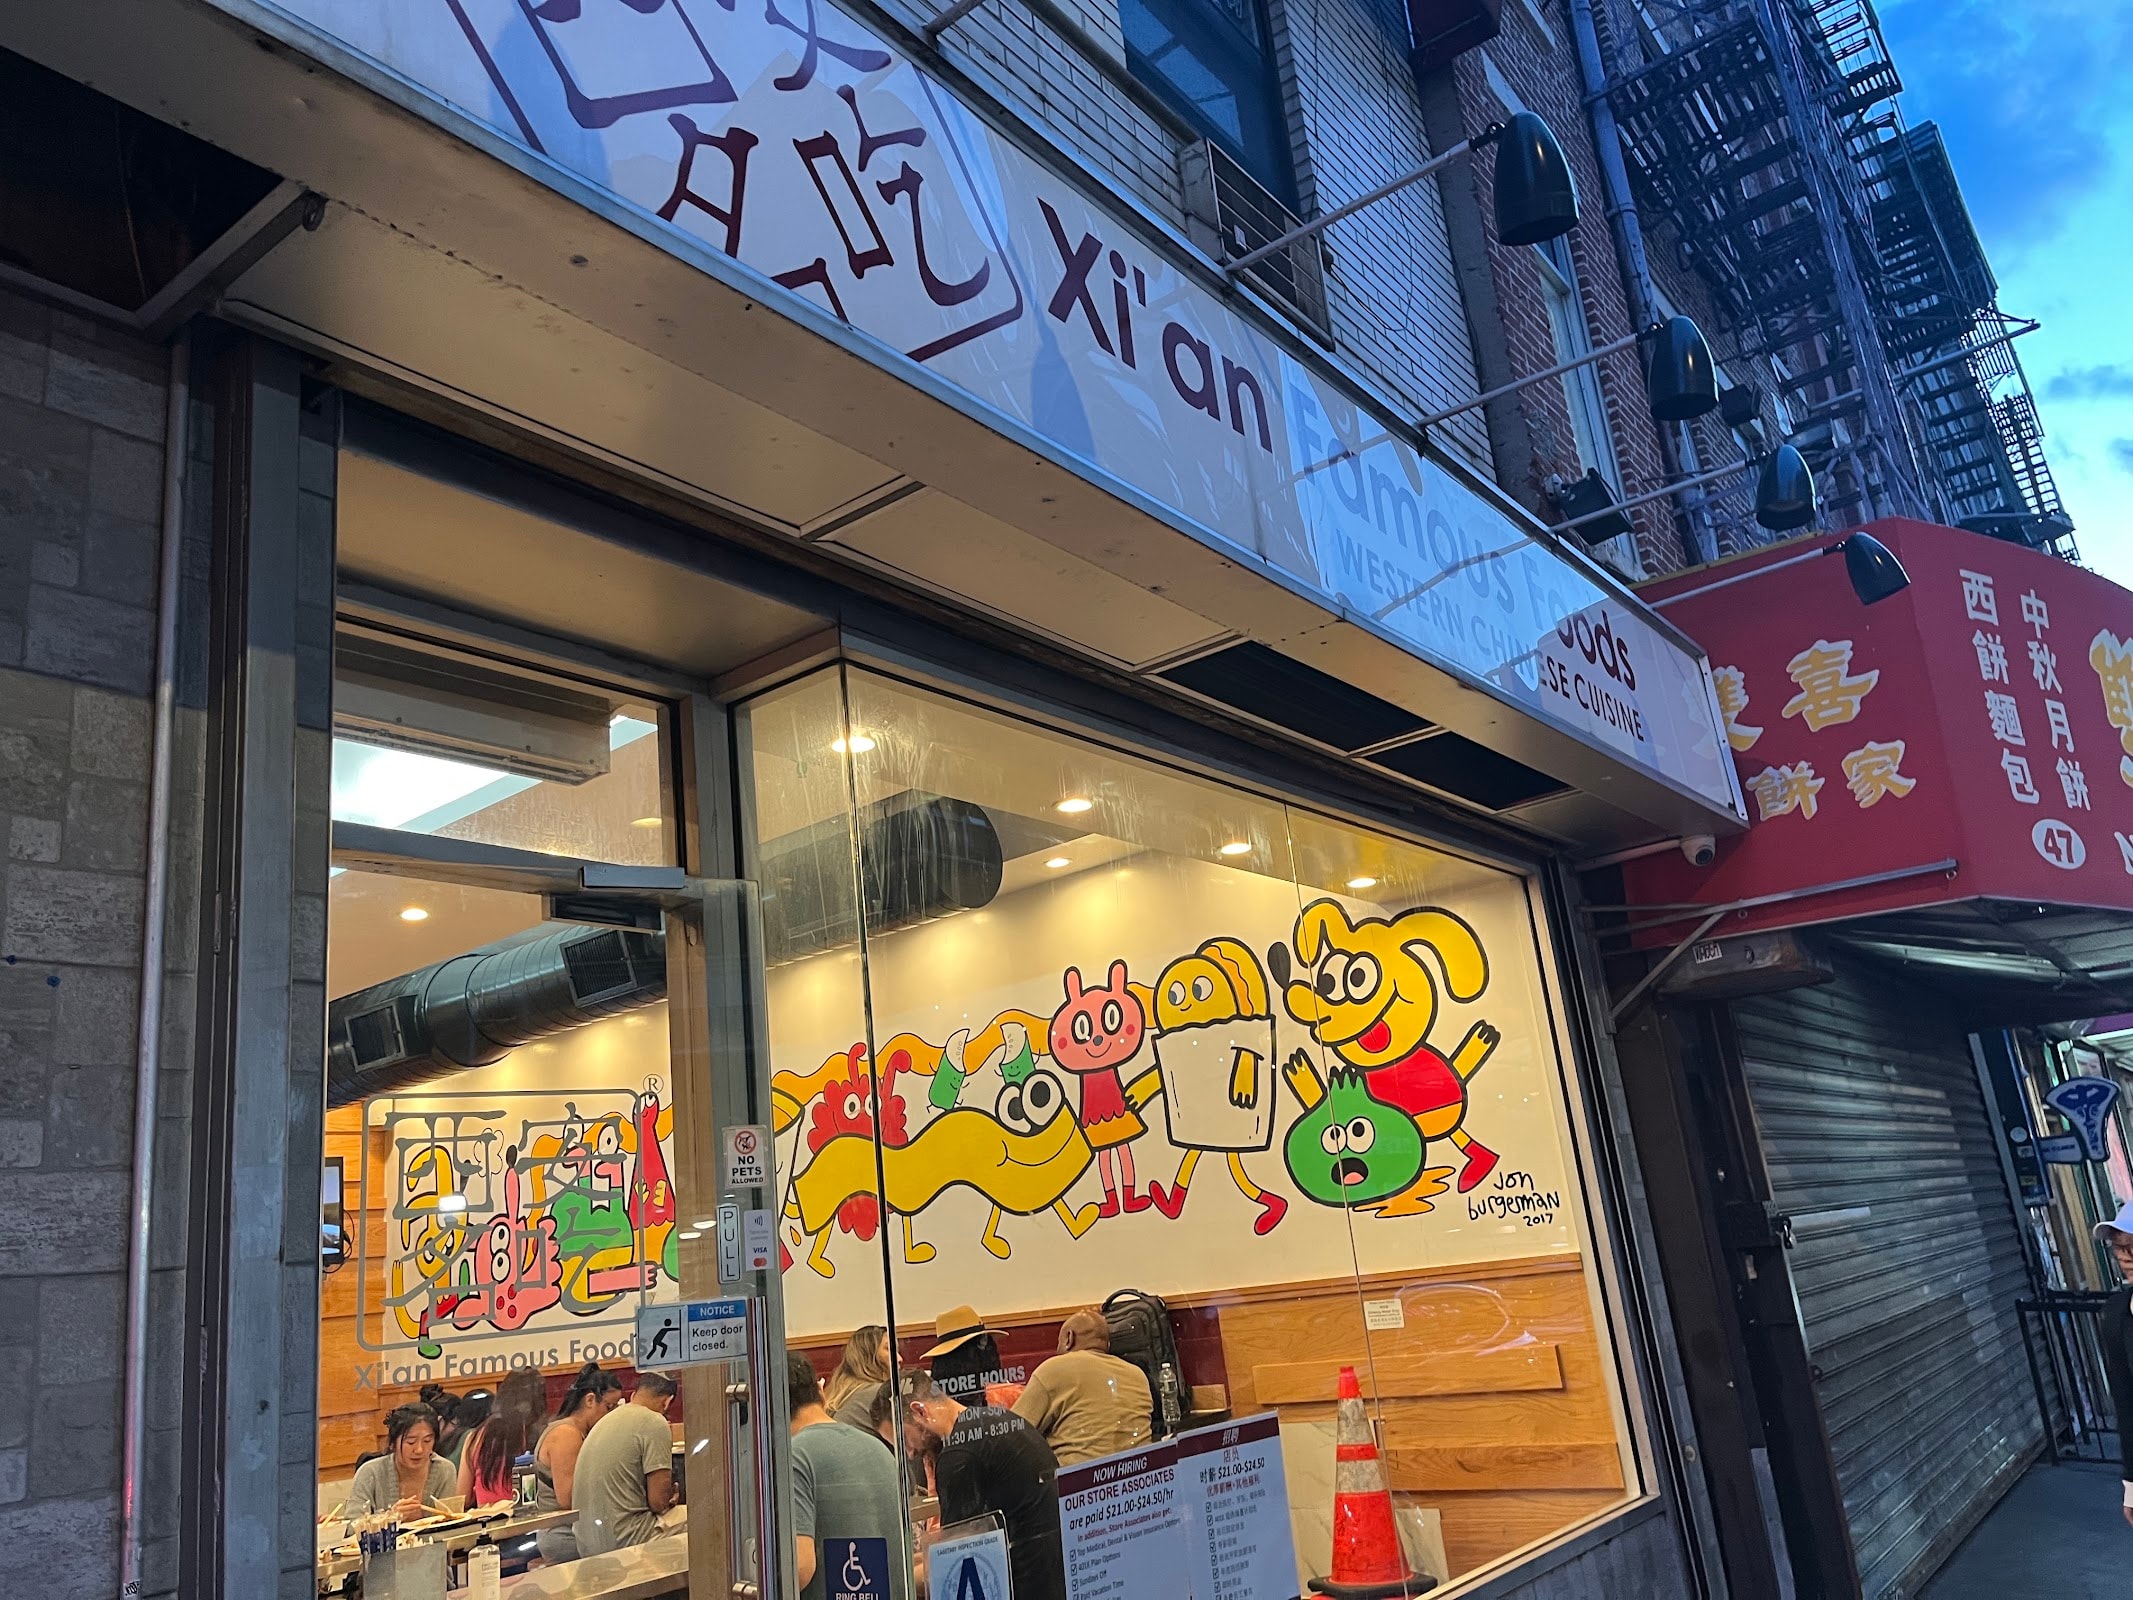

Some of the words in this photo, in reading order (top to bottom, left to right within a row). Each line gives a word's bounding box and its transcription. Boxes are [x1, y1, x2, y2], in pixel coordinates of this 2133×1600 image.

[1037, 198, 1273, 454] Xi'an
[1289, 381, 1515, 615] Famous
[1520, 551, 1637, 692] Foods
[1335, 529, 1466, 646] WESTERN
[1470, 615, 1571, 700] CHINESE
[1573, 673, 1646, 743] CUISINE
[2043, 827, 2074, 864] 47
[738, 1155, 755, 1166] NO
[731, 1177, 764, 1185] ALLOWED
[732, 1166, 762, 1177] PETS
[1522, 1213, 1554, 1227] 2017
[723, 1210, 735, 1277] PULL
[753, 1246, 768, 1254] VISA
[700, 1304, 735, 1317] NOTICE
[692, 1327, 718, 1338] Keep
[720, 1324, 744, 1336] door
[692, 1340, 729, 1352] closed.
[354, 1361, 432, 1391] Xi'an
[444, 1346, 559, 1379] Famous
[569, 1333, 647, 1363] Foods
[930, 1373, 977, 1397] STORE
[979, 1365, 1026, 1387] HOURS
[957, 1405, 981, 1423] MON
[940, 1430, 966, 1448] 11:30
[967, 1426, 983, 1442] AM
[990, 1421, 1009, 1437] 8:30
[1010, 1418, 1026, 1432] PM
[1093, 1465, 1116, 1484] NOW
[1117, 1456, 1148, 1477] HIRING
[1217, 1456, 1266, 1480] $21.00-$24.50
[1065, 1494, 1086, 1512] OUR
[1087, 1484, 1120, 1505] STORE
[1121, 1468, 1175, 1496] ASSOCIATES
[1069, 1514, 1083, 1530] are
[1085, 1507, 1105, 1529] paid
[1105, 1487, 1174, 1520] $21.00-$24.50/hr
[1108, 1522, 1124, 1534] Store
[1124, 1514, 1151, 1528] Associates
[1107, 1535, 1123, 1547] Dental
[1102, 1551, 1121, 1563] Options
[1091, 1583, 1112, 1597] Vacation
[1112, 1579, 1125, 1589] Time
